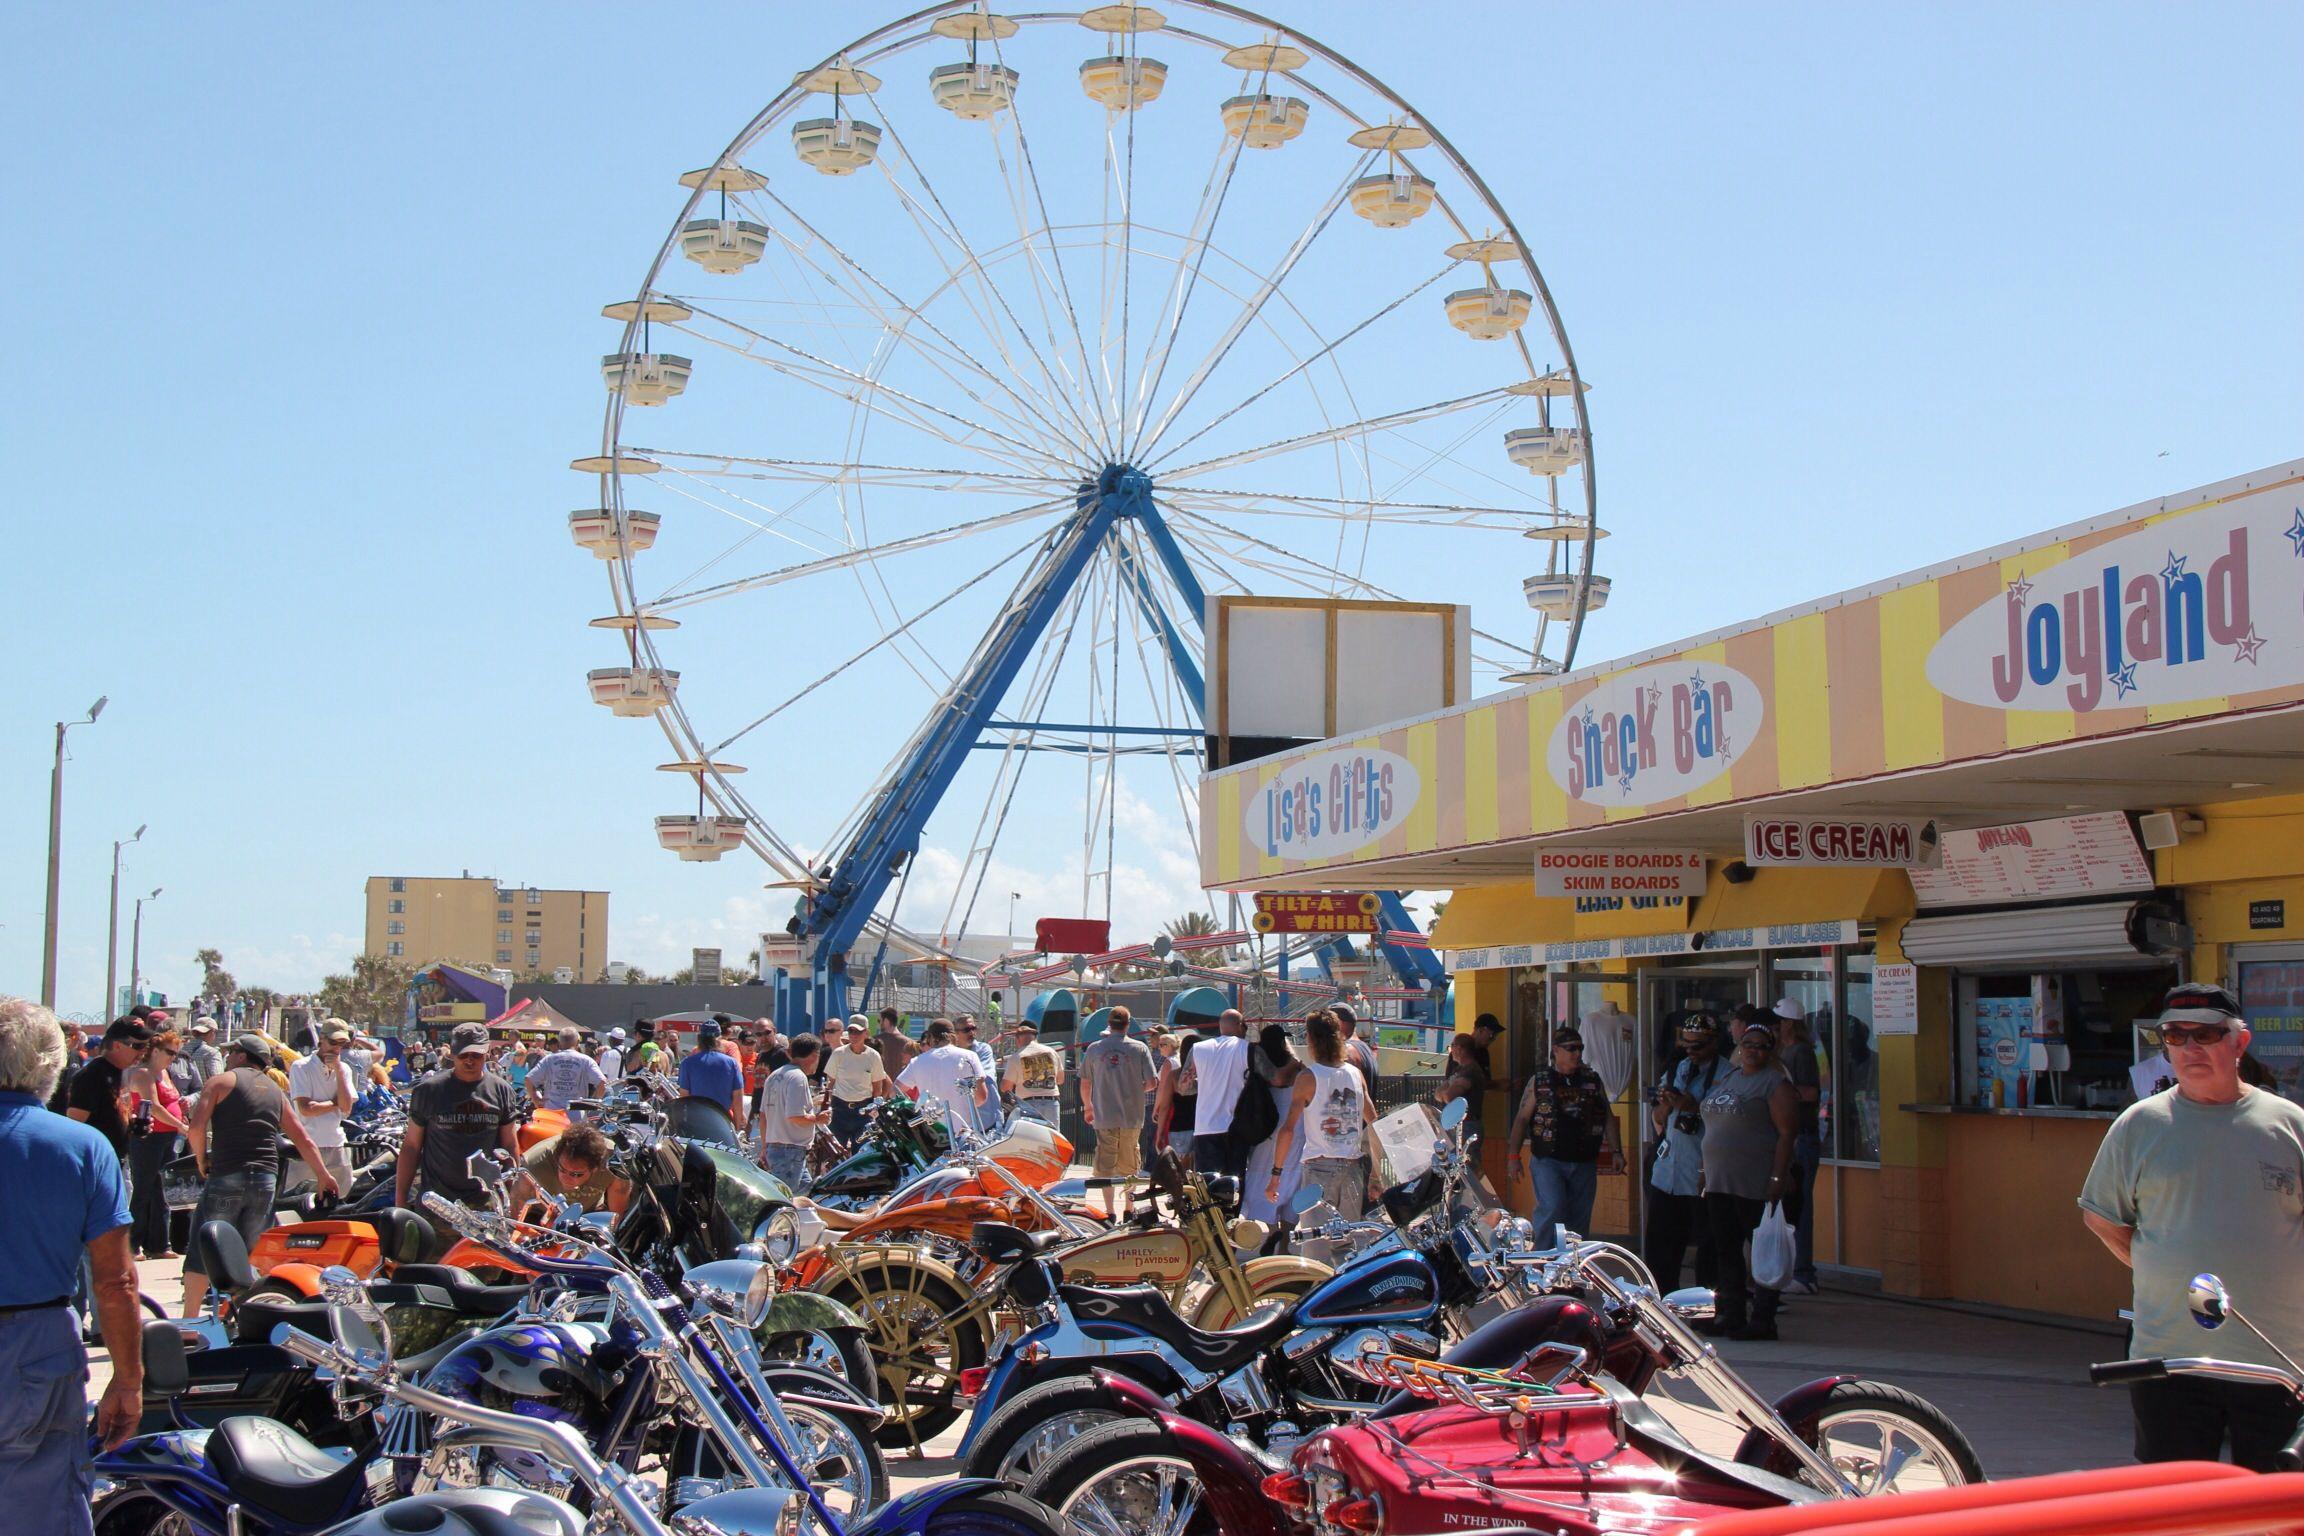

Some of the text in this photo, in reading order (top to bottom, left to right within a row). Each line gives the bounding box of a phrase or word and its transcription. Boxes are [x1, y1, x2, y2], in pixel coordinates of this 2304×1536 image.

[1991, 526, 2252, 713] Joyland
[1567, 681, 1733, 800] Snack Bar
[1266, 756, 1394, 858] Lisa's Gifts
[1753, 821, 1913, 862] ICE CREAM
[1541, 854, 1700, 868] BOOGIE BOARDS &
[1563, 876, 1680, 890] SKIM BOARDS
[1260, 896, 1341, 911] TILT-A-
[1293, 914, 1374, 930] WHIRL
[1456, 921, 1842, 969] JEWELRY T-SHIRTS BOOGIE BOARDS SKIM BOARDS SANDALS SUNGLASSES
[1877, 968, 1911, 978] ICE CREAM
[2255, 1017, 2304, 1032] BEER LIS
[1117, 1248, 1158, 1260] HARLEY-
[1135, 1256, 1180, 1268] DAVIDSON
[1443, 1513, 1527, 1528] IN THE WIND
